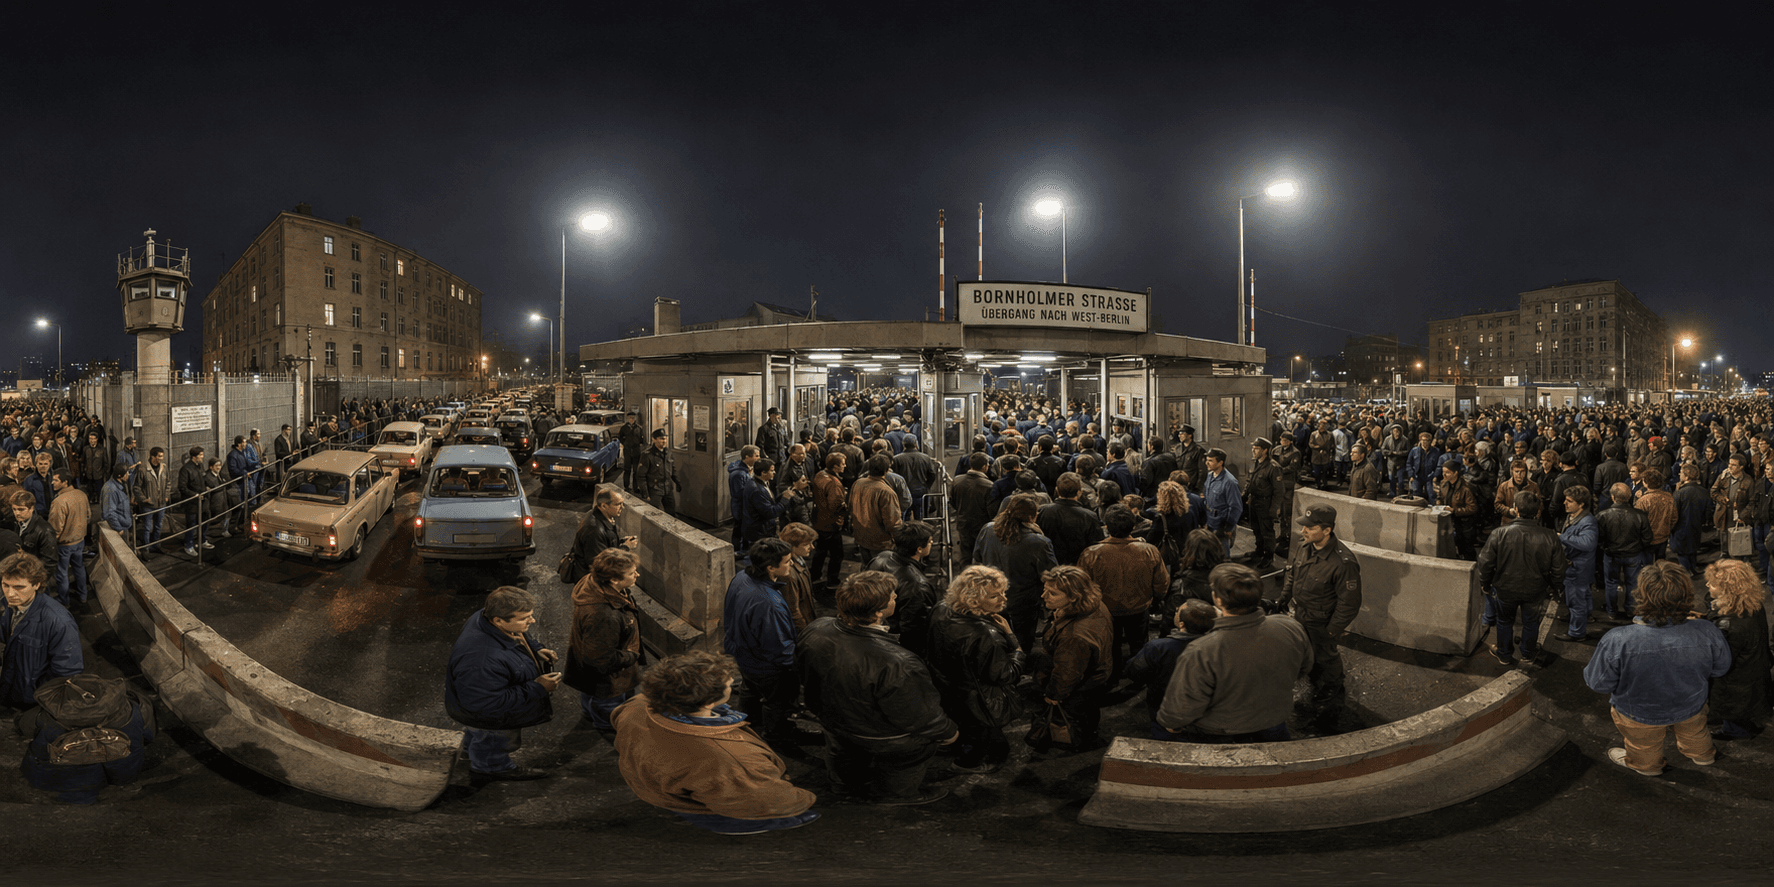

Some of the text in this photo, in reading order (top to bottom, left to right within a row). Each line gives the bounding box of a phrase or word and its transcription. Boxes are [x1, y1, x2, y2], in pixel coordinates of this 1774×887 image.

[973, 290, 1137, 312] BORNHOLMER STRASSE
[981, 307, 1130, 325] ÜBERGANG NACH WEST-BERLIN
